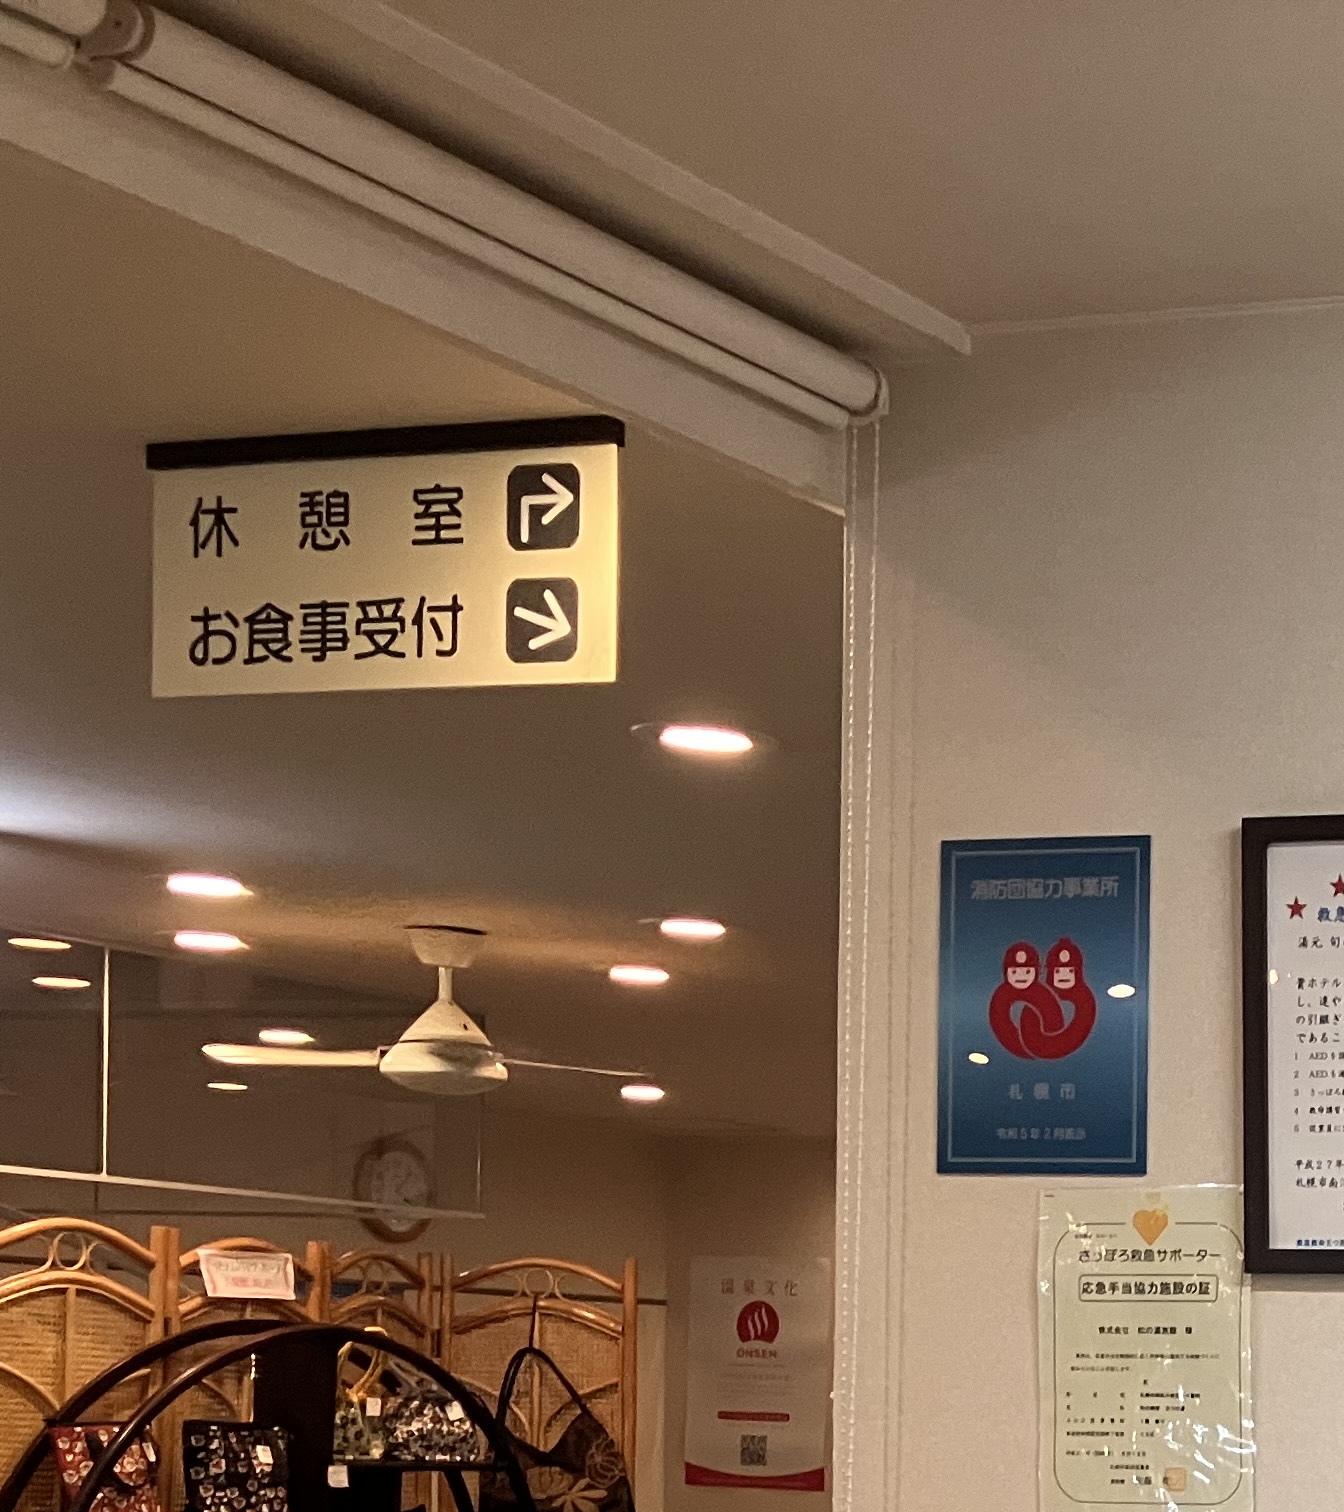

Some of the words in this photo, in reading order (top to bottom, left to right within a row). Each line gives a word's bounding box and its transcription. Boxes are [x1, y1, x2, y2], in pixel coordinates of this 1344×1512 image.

[188, 483, 464, 559] 休憩室
[188, 594, 464, 666] お食事受付
[1081, 1281, 1211, 1296] 応急手当協力施設の証
[736, 1347, 778, 1359] ONSEN
